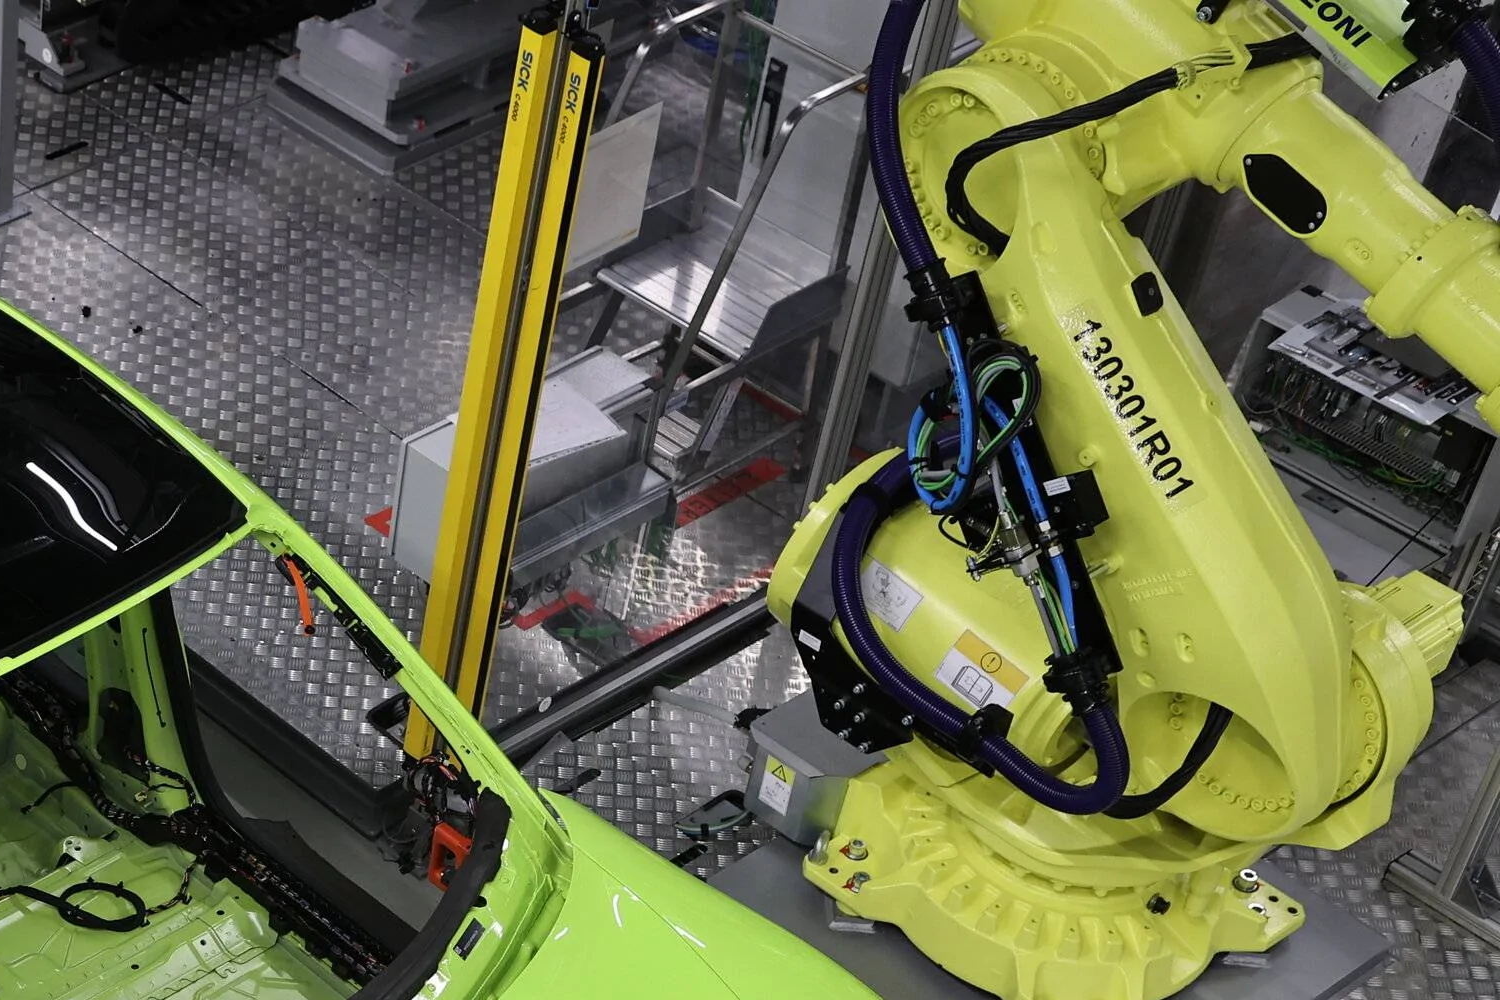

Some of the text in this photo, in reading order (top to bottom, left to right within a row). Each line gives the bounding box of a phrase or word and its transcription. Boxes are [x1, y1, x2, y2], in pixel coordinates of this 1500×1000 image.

[517, 50, 533, 92] SICK
[511, 101, 520, 122] 4000
[565, 72, 581, 114] SICK
[559, 123, 568, 144] 4000
[1073, 319, 1194, 499] 130301R01
